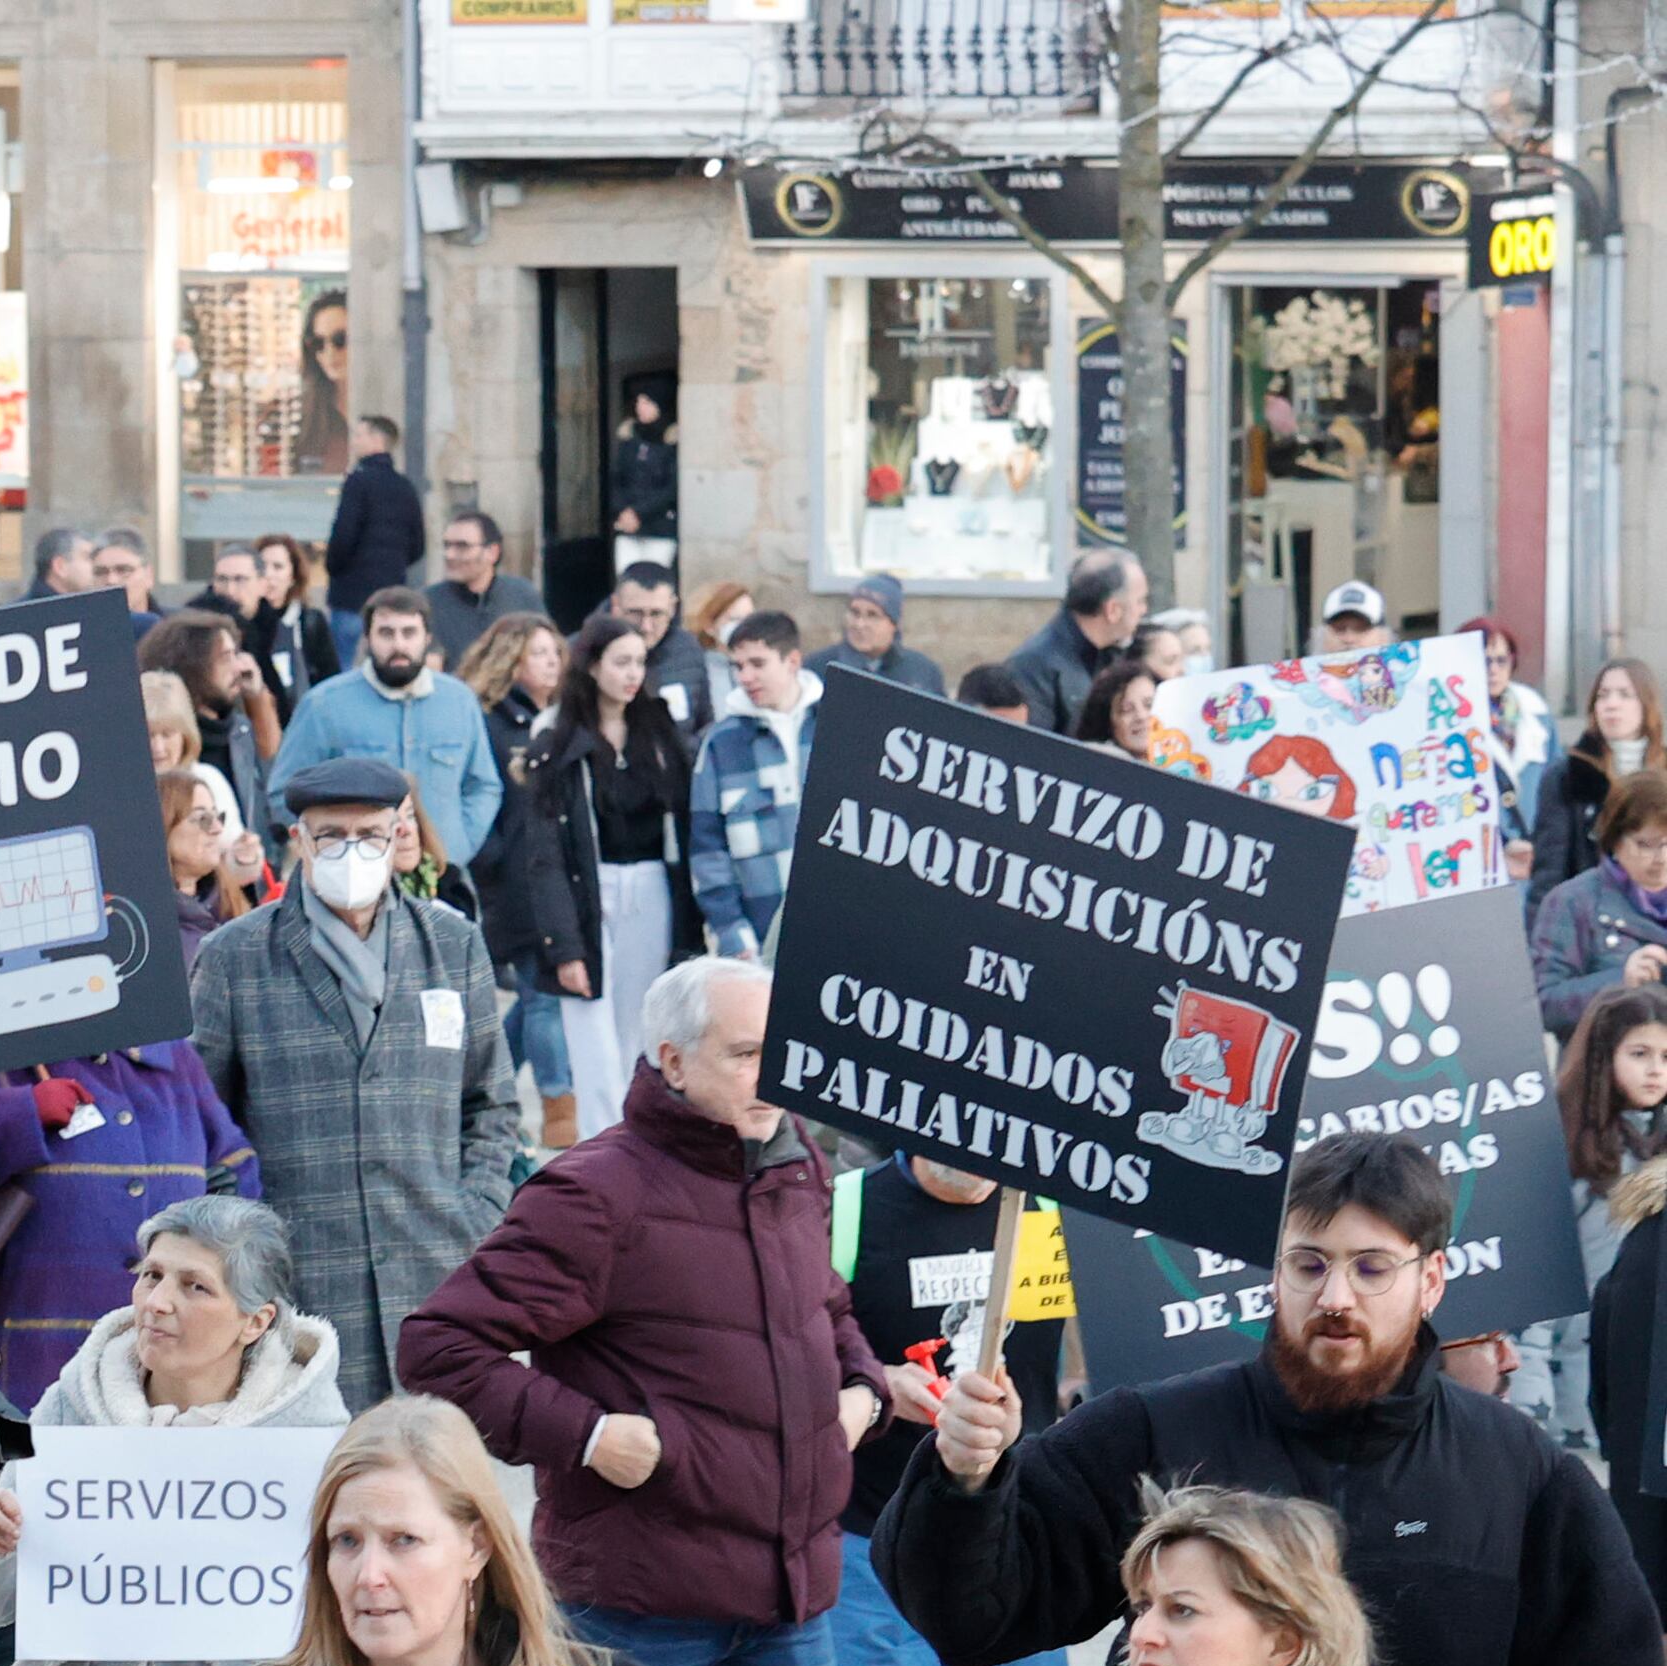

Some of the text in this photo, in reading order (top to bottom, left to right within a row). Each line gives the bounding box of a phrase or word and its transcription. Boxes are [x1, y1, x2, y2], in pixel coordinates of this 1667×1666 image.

[232, 211, 343, 240] General
[1488, 214, 1556, 279] ORO
[877, 725, 1276, 898] SERVIZO DE
[817, 796, 1304, 995] ADQUISICIÓNS
[963, 944, 1036, 1003] EN
[818, 972, 1136, 1119] COIDADOS
[1307, 963, 1463, 1081] S!!
[777, 1038, 1152, 1206] PALIATIVOS
[1294, 1070, 1547, 1154] CARIOS/AS
[917, 1273, 989, 1302] RESPEC
[1160, 1298, 1227, 1339] DE
[44, 1479, 288, 1520] SERVIZOS
[47, 1553, 295, 1606] PÚBLICOS
